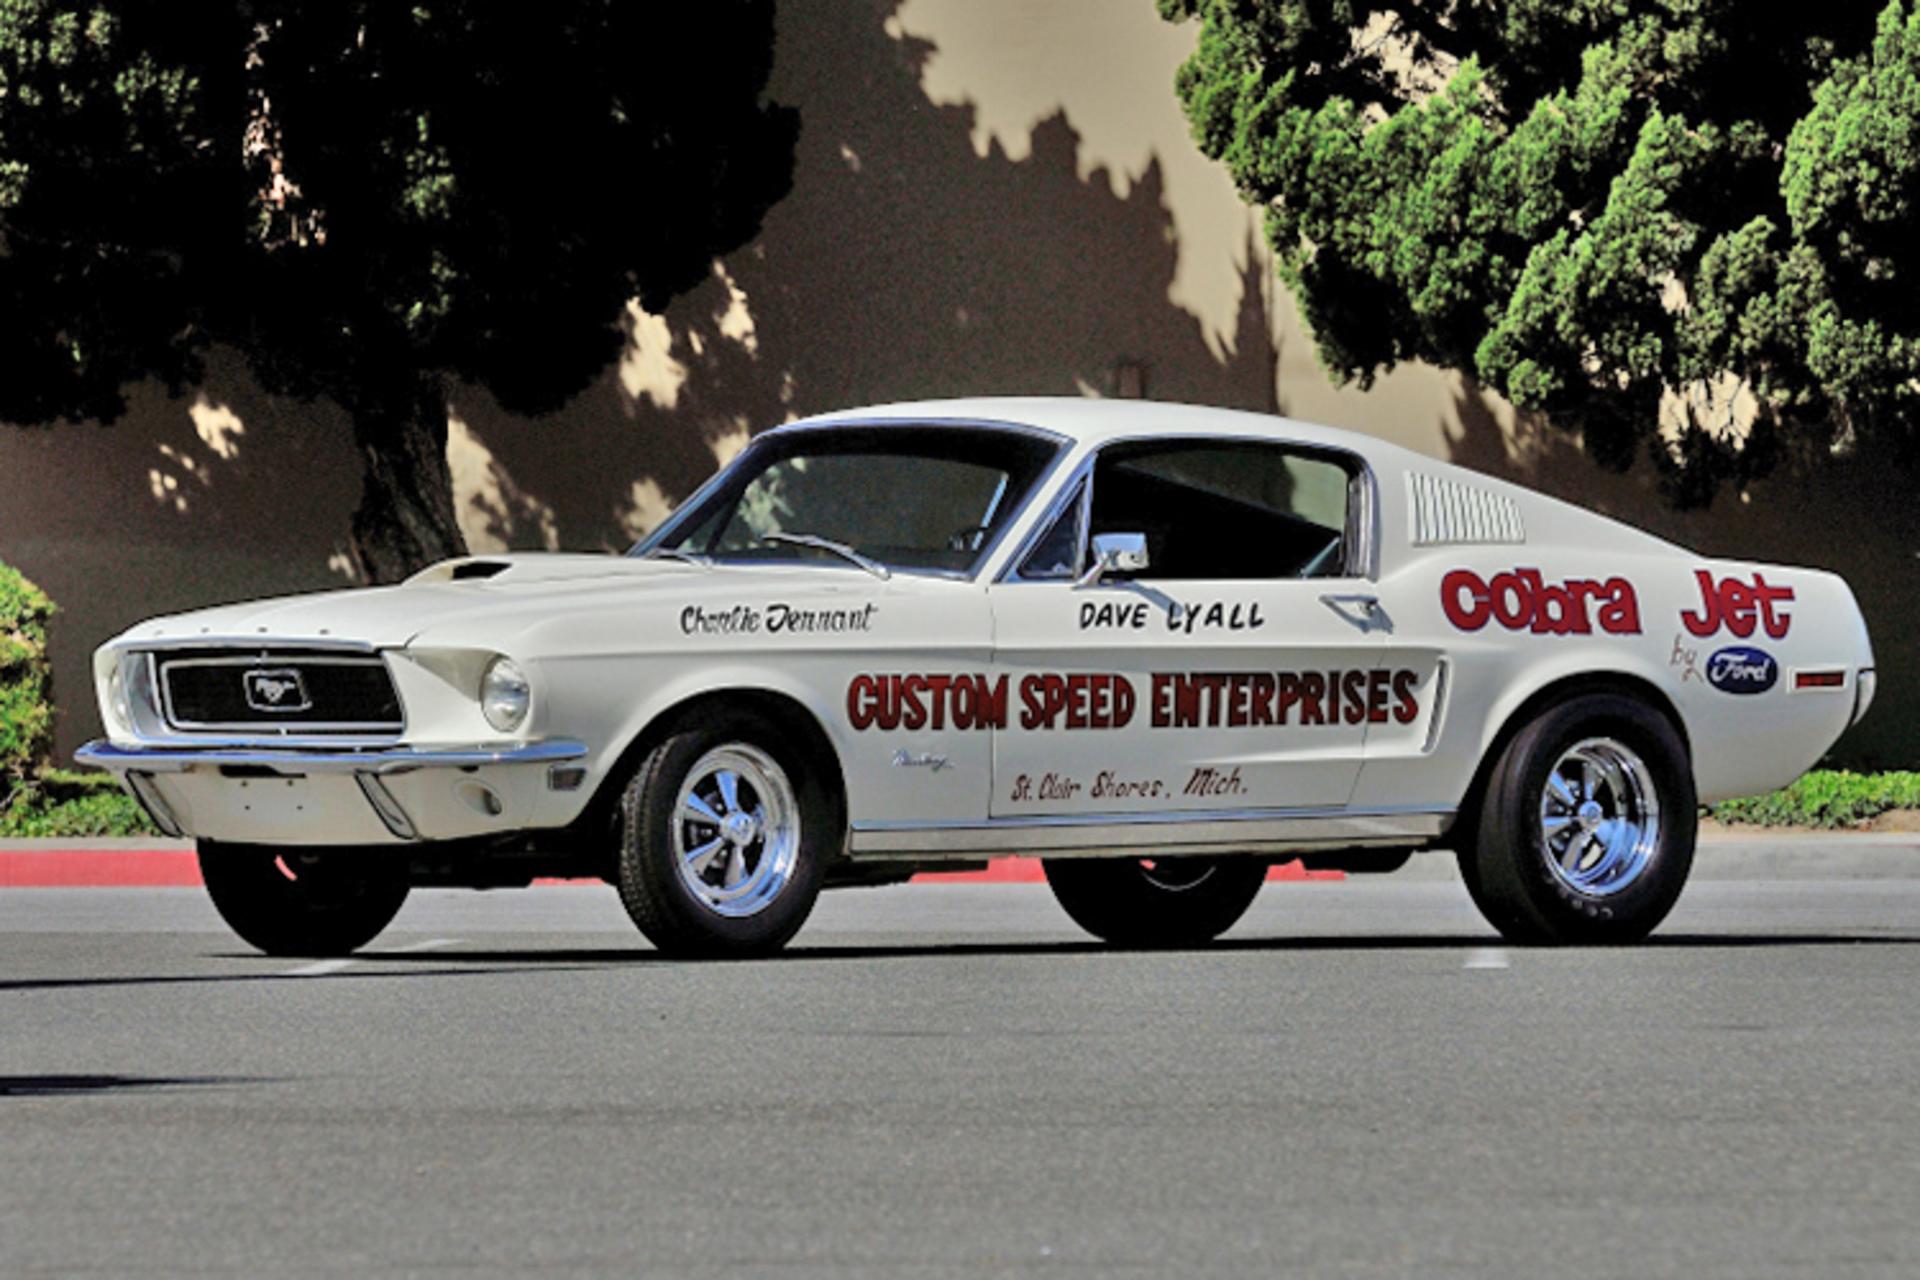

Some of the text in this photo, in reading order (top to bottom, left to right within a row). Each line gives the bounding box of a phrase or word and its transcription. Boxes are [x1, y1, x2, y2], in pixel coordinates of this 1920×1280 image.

[1080, 602, 1265, 634] DAVE LYALL
[1680, 570, 1795, 638] Jet
[1669, 633, 1704, 683] by
[1711, 652, 1770, 682] Ford
[847, 669, 1419, 731] CUSTOM SPEED ENTERPRISES
[1183, 765, 1248, 796] Mich.
